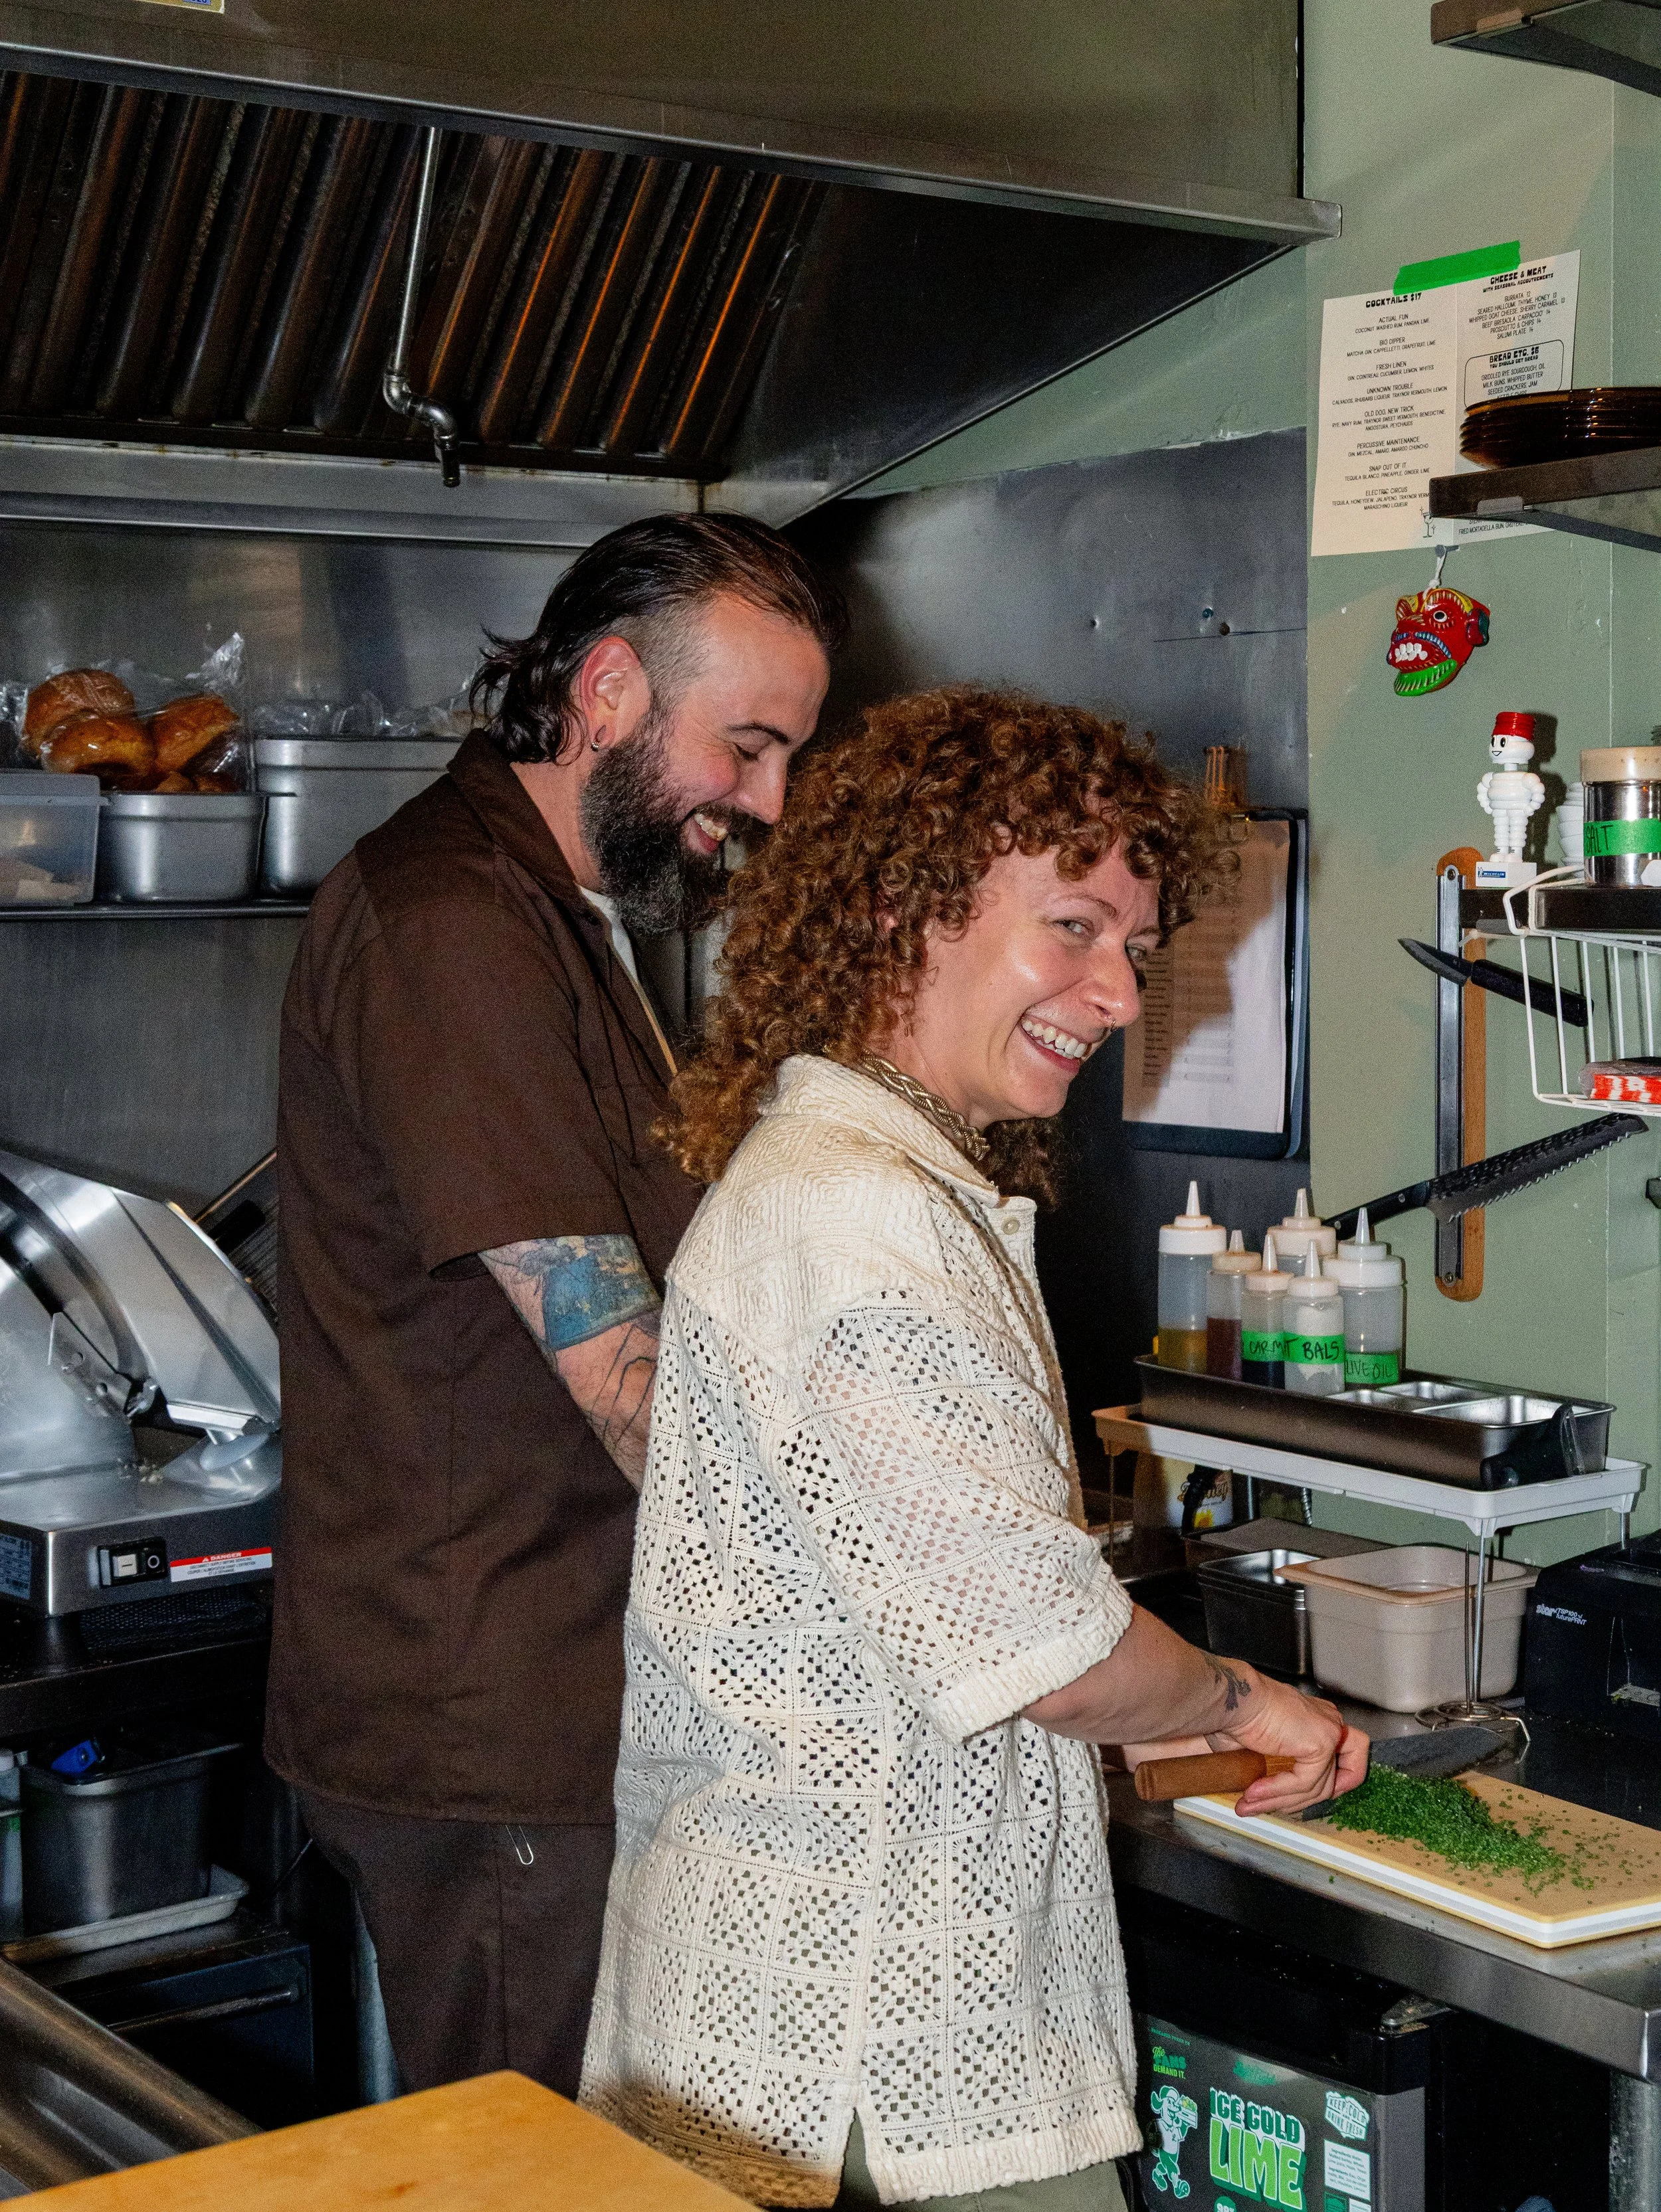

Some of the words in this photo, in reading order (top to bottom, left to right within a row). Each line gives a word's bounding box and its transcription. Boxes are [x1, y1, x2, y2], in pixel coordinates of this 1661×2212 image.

[1490, 272, 1518, 284] CHEESE
[1527, 265, 1546, 277] MEAT
[1494, 282, 1515, 290] SEASONAL
[1365, 294, 1408, 308] COCKTAILS
[1411, 292, 1422, 302] $17
[1504, 292, 1523, 302] BURRATA
[1468, 314, 1487, 323] WHIPPED
[1488, 311, 1500, 320] GOAT
[1519, 304, 1536, 312] SHERRY
[1537, 299, 1557, 308] CARAMEL
[1477, 306, 1493, 315] SEARED
[1535, 294, 1550, 302] HONEY
[1490, 323, 1515, 334] PROSCIUTTO
[1521, 319, 1534, 327] CHIPS
[1494, 316, 1515, 326] BRESAOLA
[1497, 331, 1512, 339] SALUMI
[1513, 327, 1526, 336] PLATE
[1389, 336, 1405, 345] DIPPER
[1489, 351, 1512, 363] BREAD
[1513, 348, 1529, 359] ETC.
[1481, 371, 1501, 381] GRIDDLED
[1507, 374, 1525, 383] WHIPPED
[1527, 371, 1543, 380] BUTTER
[1393, 382, 1413, 391] TROUBLE
[1488, 386, 1503, 395] SEEDED
[1357, 440, 1385, 449] PERCUSSIVE
[1386, 436, 1419, 446] MAINTENANCE
[1587, 825, 1613, 855] SALT
[1302, 1341, 1339, 1360] BALS
[1373, 1364, 1393, 1379] OIL
[1152, 2046, 1165, 2058] The
[1153, 2064, 1177, 2076] DEMAND
[1210, 2087, 1244, 2125] ICE
[1246, 2101, 1302, 2144] COLD
[1346, 2122, 1363, 2136] FRESH
[1210, 2118, 1303, 2210] LIME
